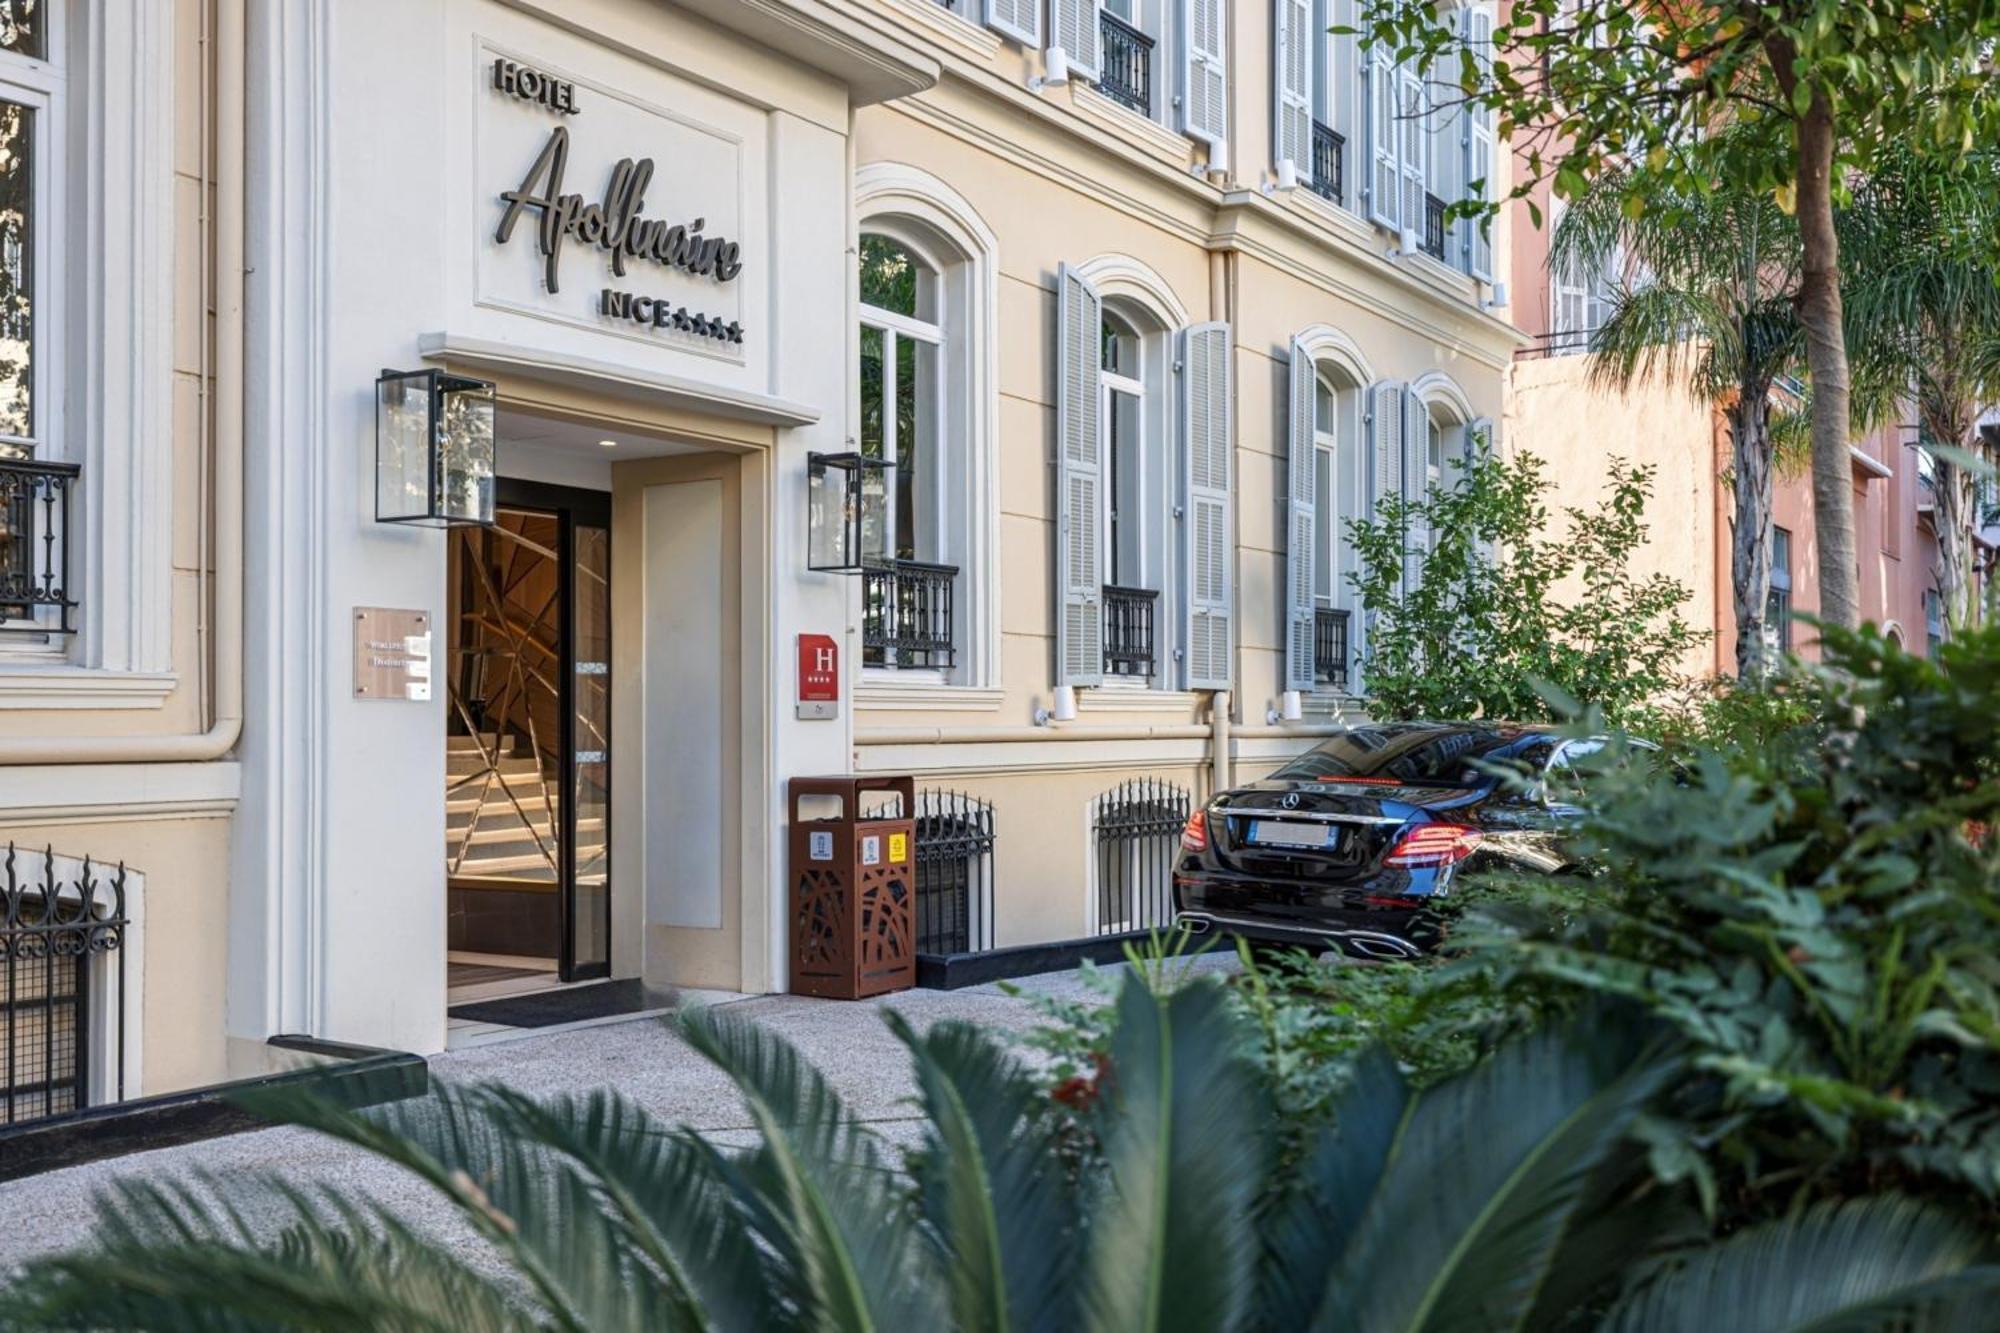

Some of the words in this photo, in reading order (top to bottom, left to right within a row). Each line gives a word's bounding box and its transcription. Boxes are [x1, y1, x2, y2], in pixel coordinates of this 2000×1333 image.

[494, 59, 580, 115] HOTEL
[496, 126, 742, 294] Apollinaire
[601, 289, 670, 327] NICE
[816, 647, 834, 673] H
